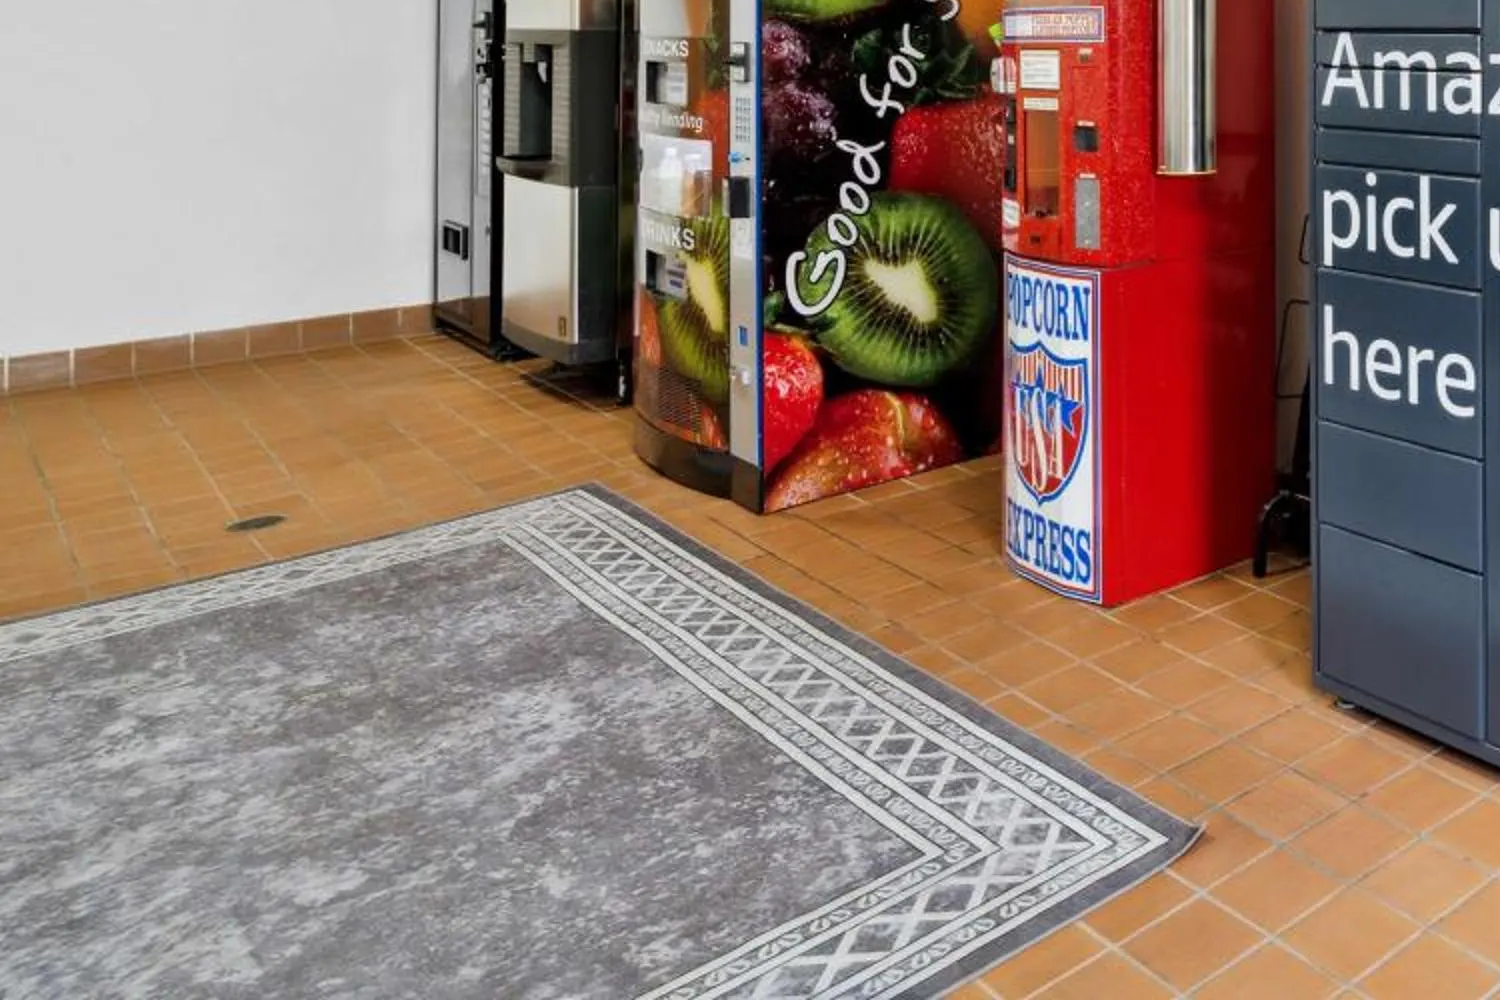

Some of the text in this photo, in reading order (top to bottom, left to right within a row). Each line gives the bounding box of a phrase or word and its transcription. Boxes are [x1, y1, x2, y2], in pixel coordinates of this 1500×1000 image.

[643, 39, 689, 58] NACKS
[786, 139, 886, 316] Good
[860, 23, 926, 118] for
[642, 221, 695, 251] RINKS
[1323, 172, 1459, 267] pick
[1007, 271, 1090, 341] POPCORN
[1324, 304, 1476, 417] here
[1016, 387, 1063, 491] USA
[1008, 497, 1090, 583] EXPRESS
